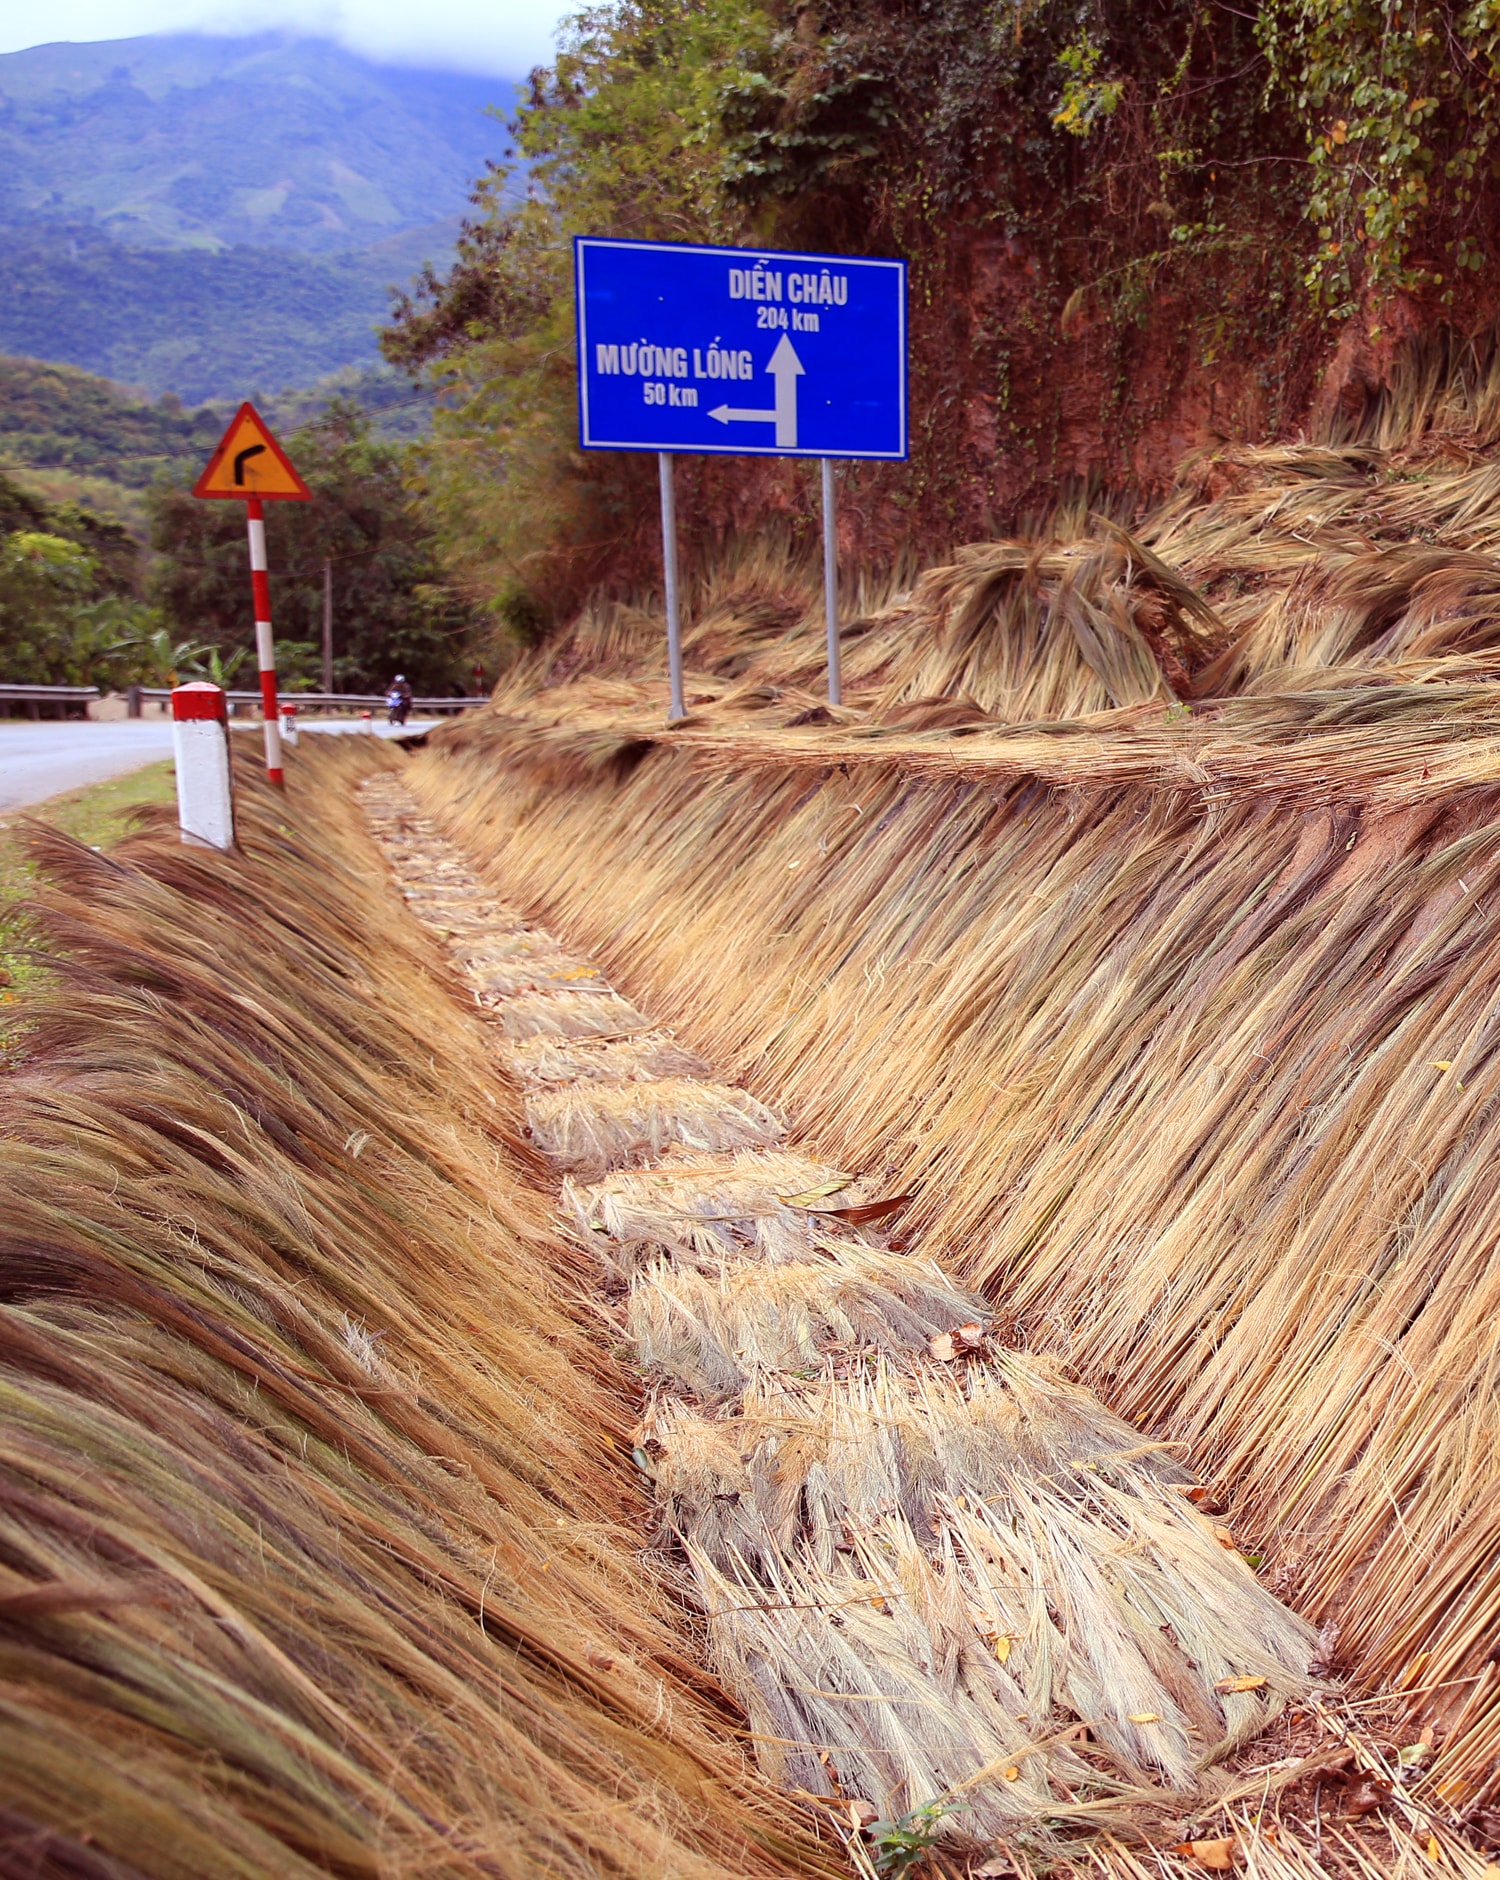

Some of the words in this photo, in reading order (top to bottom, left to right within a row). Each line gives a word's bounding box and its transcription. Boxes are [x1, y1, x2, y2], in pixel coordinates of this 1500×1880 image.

[728, 258, 783, 302] DIỄN
[756, 305, 789, 330] 204
[791, 307, 820, 333] km
[595, 337, 689, 378] MƯỜNG
[692, 335, 753, 380] LỐNG
[643, 381, 666, 405] 50
[668, 382, 698, 407] km
